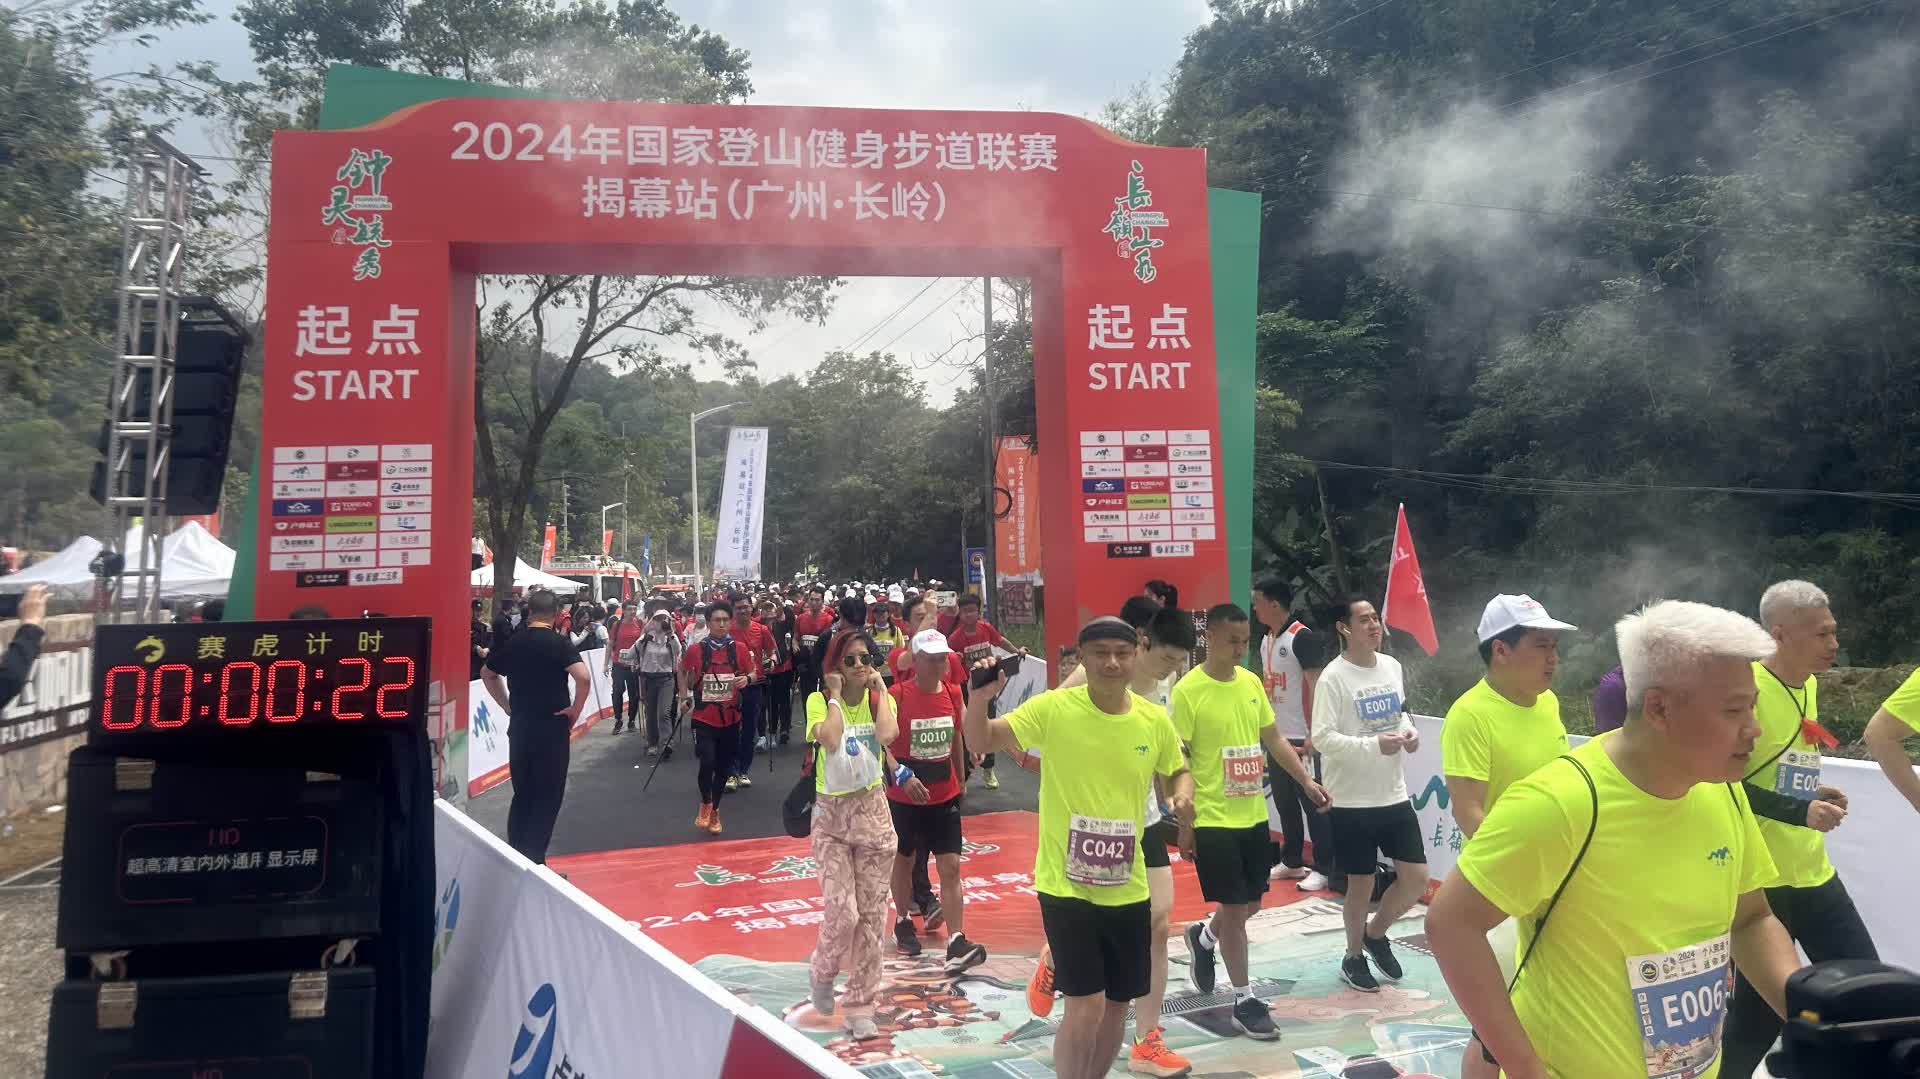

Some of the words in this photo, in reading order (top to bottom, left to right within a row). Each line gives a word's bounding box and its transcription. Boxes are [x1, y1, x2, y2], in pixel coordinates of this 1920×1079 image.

[450, 120, 1058, 172] 2024年国家登山健身步道联赛
[294, 303, 422, 358] 起点
[1087, 303, 1193, 351] 起点
[292, 368, 420, 401] START
[1088, 361, 1192, 391] START
[198, 629, 385, 659] 赛虎计时
[102, 656, 416, 730] 00:00:22
[1365, 697, 1392, 714] E007
[920, 731, 947, 744] 0010
[1792, 772, 1822, 791] E00
[1082, 839, 1125, 859] C042
[1661, 980, 1723, 1028] E006
